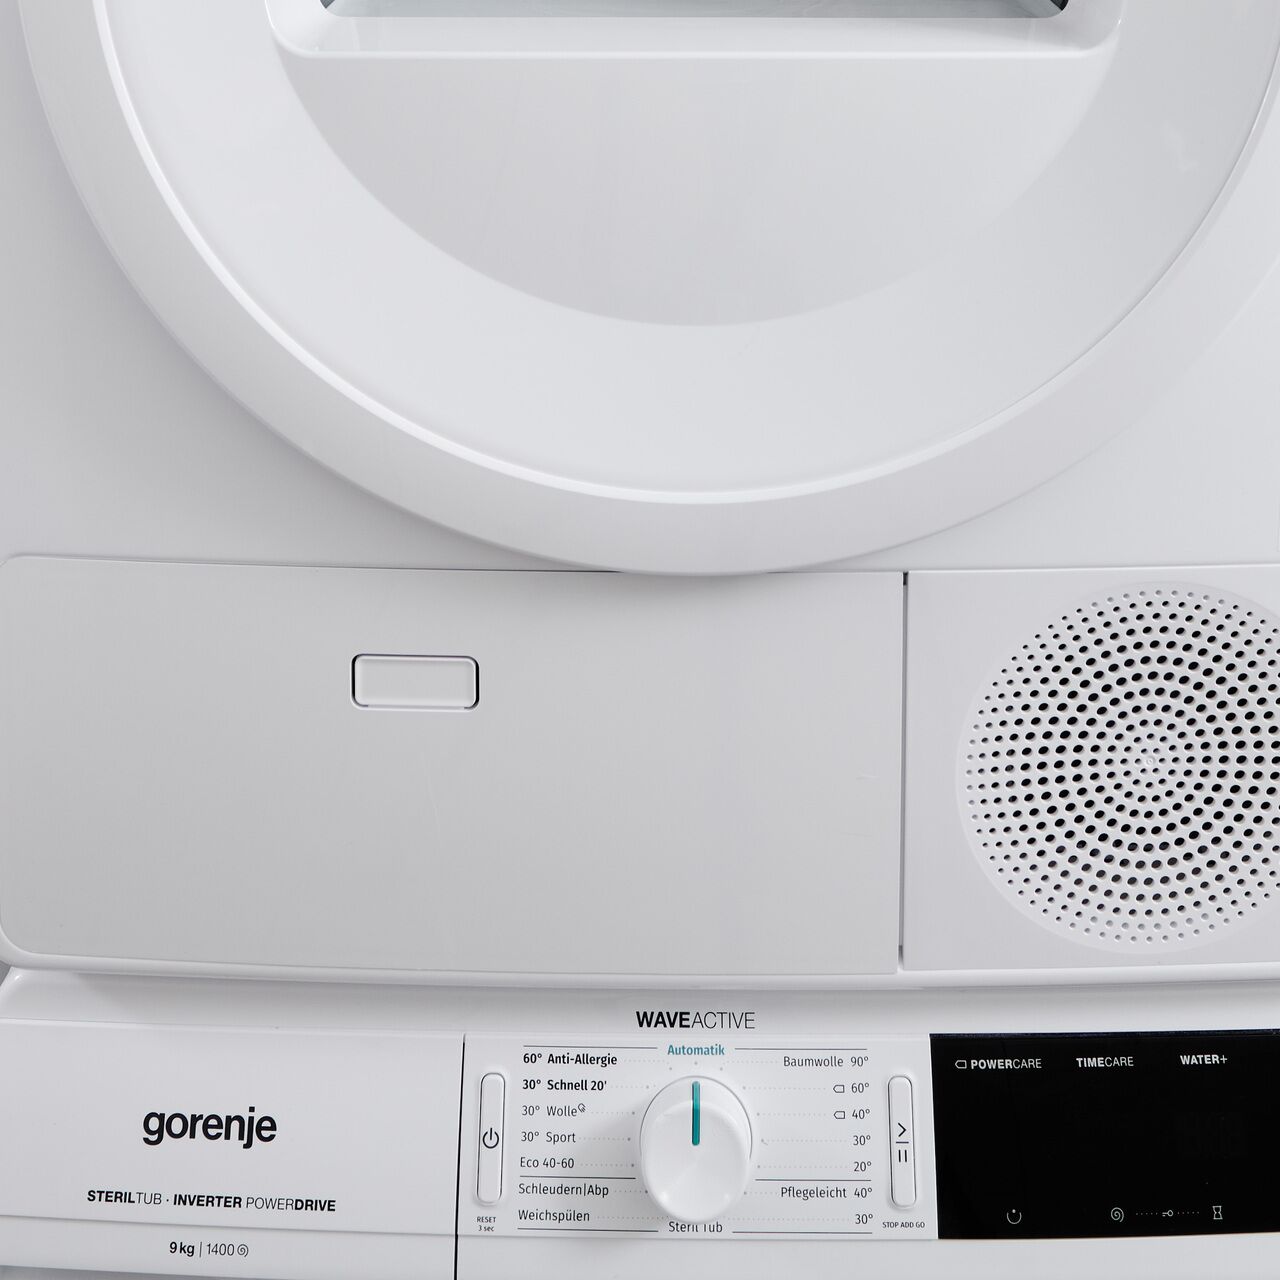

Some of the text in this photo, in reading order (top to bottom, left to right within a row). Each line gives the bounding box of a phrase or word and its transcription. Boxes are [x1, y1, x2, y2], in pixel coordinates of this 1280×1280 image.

[635, 1011, 756, 1029] WAVEACTIVE
[667, 1044, 725, 1056] Automatik
[523, 1053, 618, 1067] 60° Anti-Allergie
[783, 1056, 869, 1067] Baumwolle 90°
[970, 1057, 1042, 1070] POWERCARE
[1076, 1055, 1135, 1068] TIMECARE
[1180, 1053, 1228, 1066] WATER+
[522, 1079, 607, 1091] 30° Schnell 20'
[851, 1083, 870, 1093] 60°
[521, 1105, 578, 1117] 30° Wolle
[851, 1109, 871, 1120] 40°
[142, 1106, 277, 1150] gorenje
[521, 1131, 577, 1144] 30° Sport
[852, 1135, 871, 1146] 30°
[520, 1157, 575, 1169] Eco 40-60
[853, 1161, 872, 1172] 20°
[518, 1183, 609, 1197] Schleudern|Abp
[781, 1187, 873, 1200] Pflegeleicht 40°
[86, 1189, 337, 1213] STERILTUB INVERTER POWERDRIVE
[476, 1216, 496, 1224] RESET
[518, 1209, 591, 1223] Weichspülen
[854, 1214, 874, 1225] 30°
[882, 1221, 926, 1229] STOP ADD GO
[206, 1243, 235, 1256] 1400
